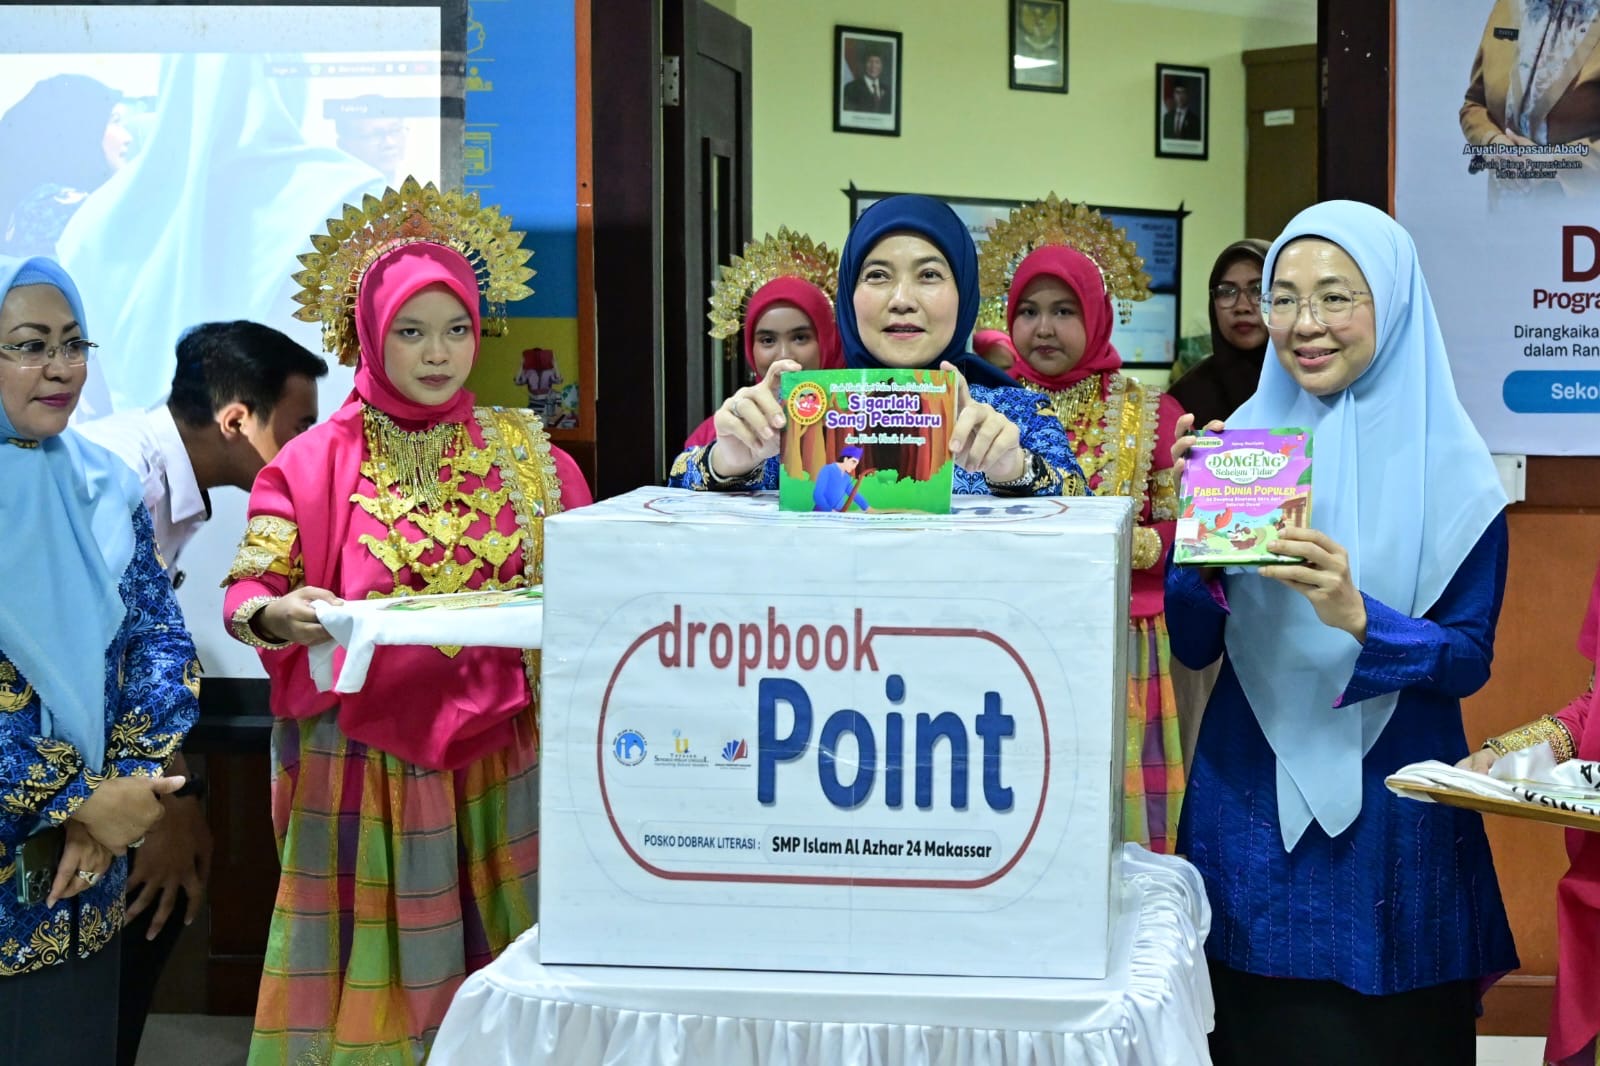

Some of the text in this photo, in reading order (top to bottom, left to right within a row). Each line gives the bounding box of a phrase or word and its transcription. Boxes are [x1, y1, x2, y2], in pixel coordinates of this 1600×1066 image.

[1463, 144, 1589, 156] Aryati Puspasari Abady
[1514, 325, 1600, 341] Dirangkaika
[1524, 343, 1600, 357] dalam Ran
[849, 395, 919, 412] Sigarlaki
[827, 411, 941, 429] Sang Pemburu
[1193, 485, 1297, 497] FABEL DUNIA POPULER
[658, 604, 879, 687] dropbook
[757, 674, 1015, 811] Point
[644, 834, 676, 847] POSKO
[677, 835, 715, 849] DOBRAK
[717, 837, 756, 850] LITERASI
[772, 836, 801, 853] SMP
[803, 837, 842, 854] Islam
[845, 838, 860, 855] Al
[862, 839, 904, 856] Azhar
[906, 840, 922, 857] 24
[924, 840, 992, 858] Makassar
